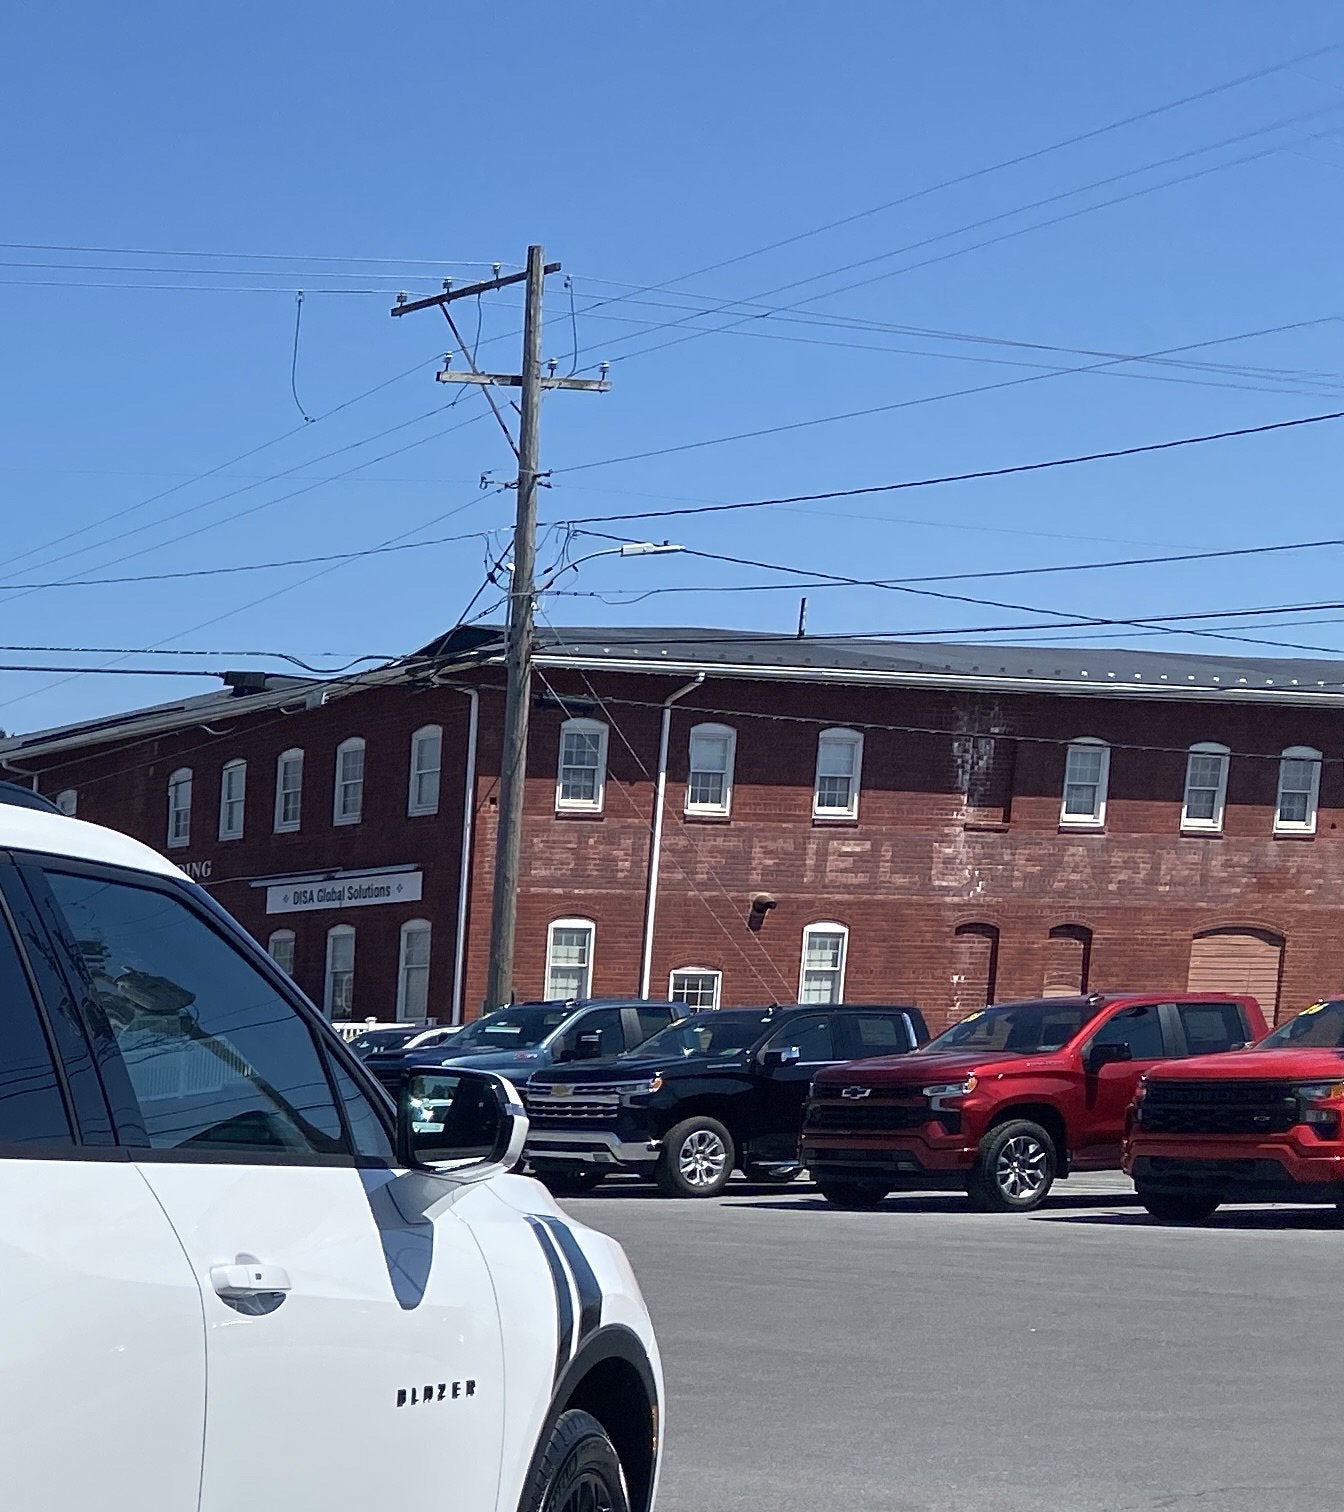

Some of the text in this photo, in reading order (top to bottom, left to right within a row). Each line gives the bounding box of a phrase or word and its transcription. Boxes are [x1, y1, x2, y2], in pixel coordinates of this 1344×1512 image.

[293, 883, 392, 905] DISA Global Solutions
[396, 1379, 477, 1408] BLAZER
